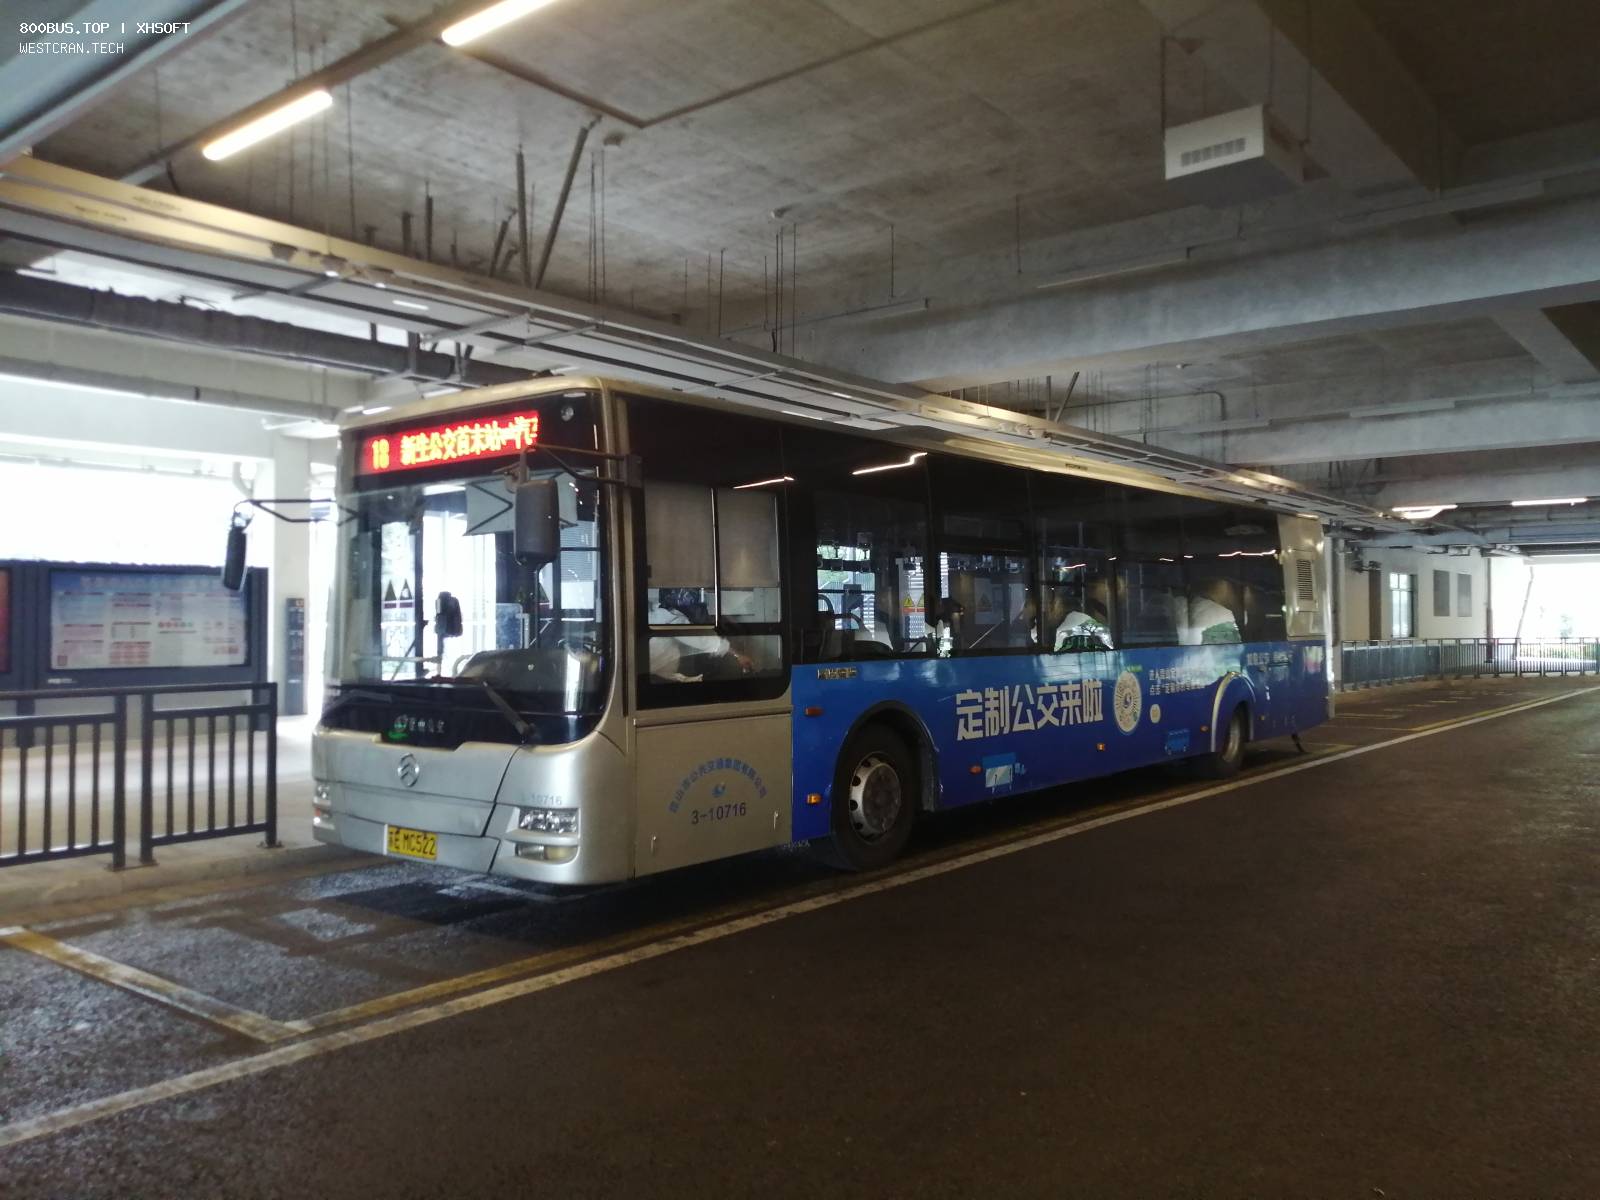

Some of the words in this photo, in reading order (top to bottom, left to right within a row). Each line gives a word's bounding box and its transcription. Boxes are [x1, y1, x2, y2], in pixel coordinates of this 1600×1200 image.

[956, 679, 1103, 741] 定制公交来啦
[691, 802, 747, 825] 3-10716
